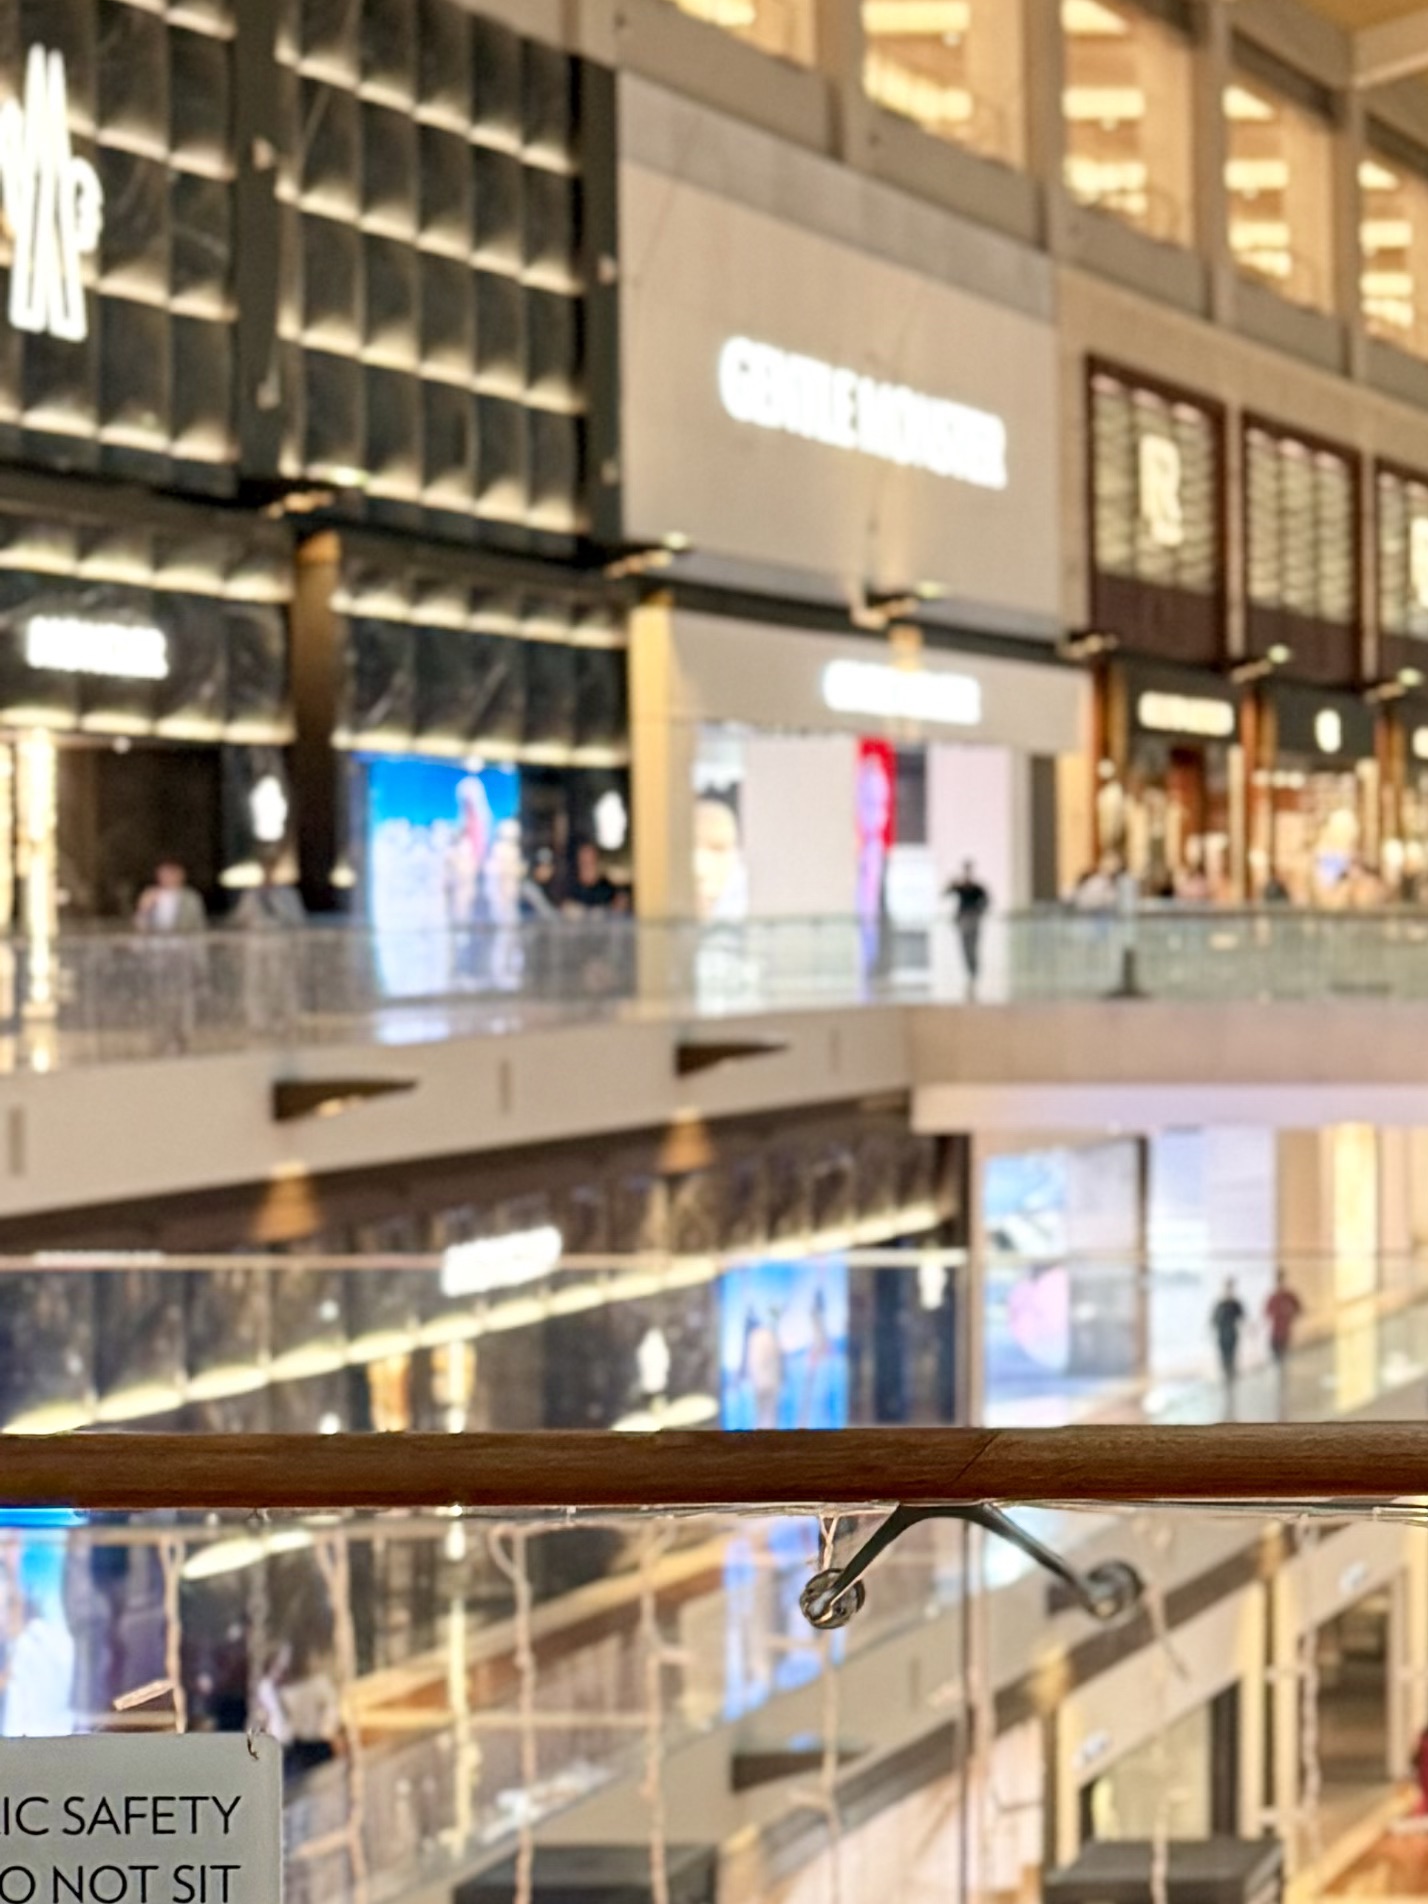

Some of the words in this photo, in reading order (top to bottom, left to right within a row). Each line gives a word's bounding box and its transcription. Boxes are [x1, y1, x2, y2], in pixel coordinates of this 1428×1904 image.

[0, 1795, 49, 1836] IC
[62, 1795, 242, 1836] SAFETY
[0, 1864, 36, 1904] O
[53, 1864, 160, 1904] NOT
[172, 1864, 242, 1904] SIT
